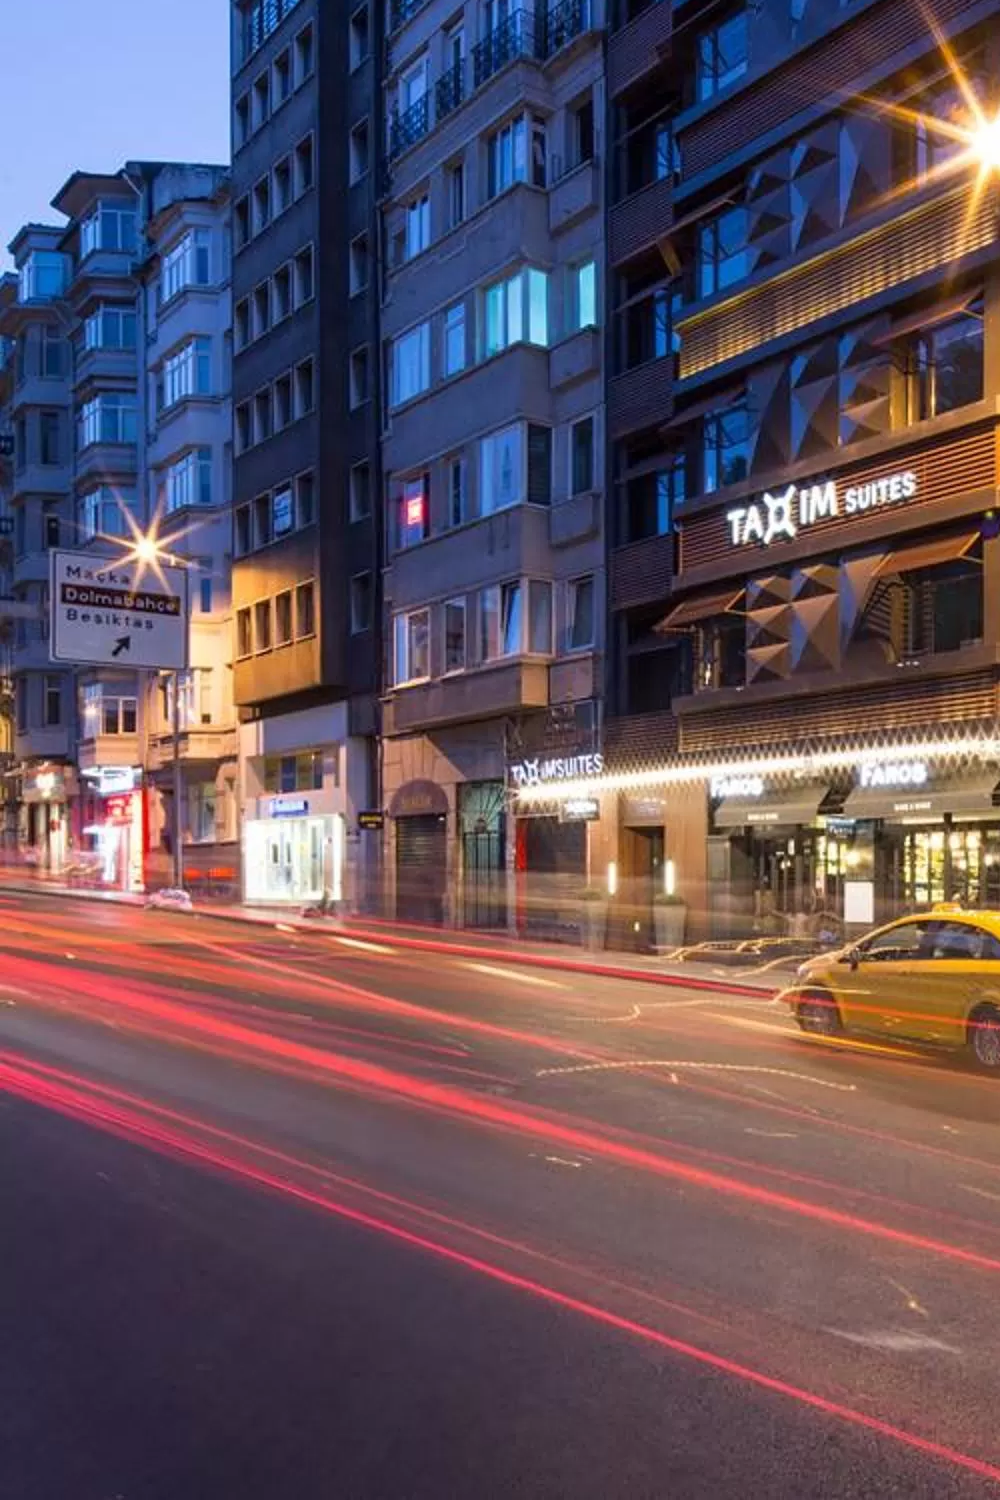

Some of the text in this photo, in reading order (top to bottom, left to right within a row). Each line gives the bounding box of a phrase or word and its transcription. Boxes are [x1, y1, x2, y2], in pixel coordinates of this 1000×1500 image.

[727, 471, 917, 545] TAXIM SUITES
[556, 753, 604, 777] SUITES
